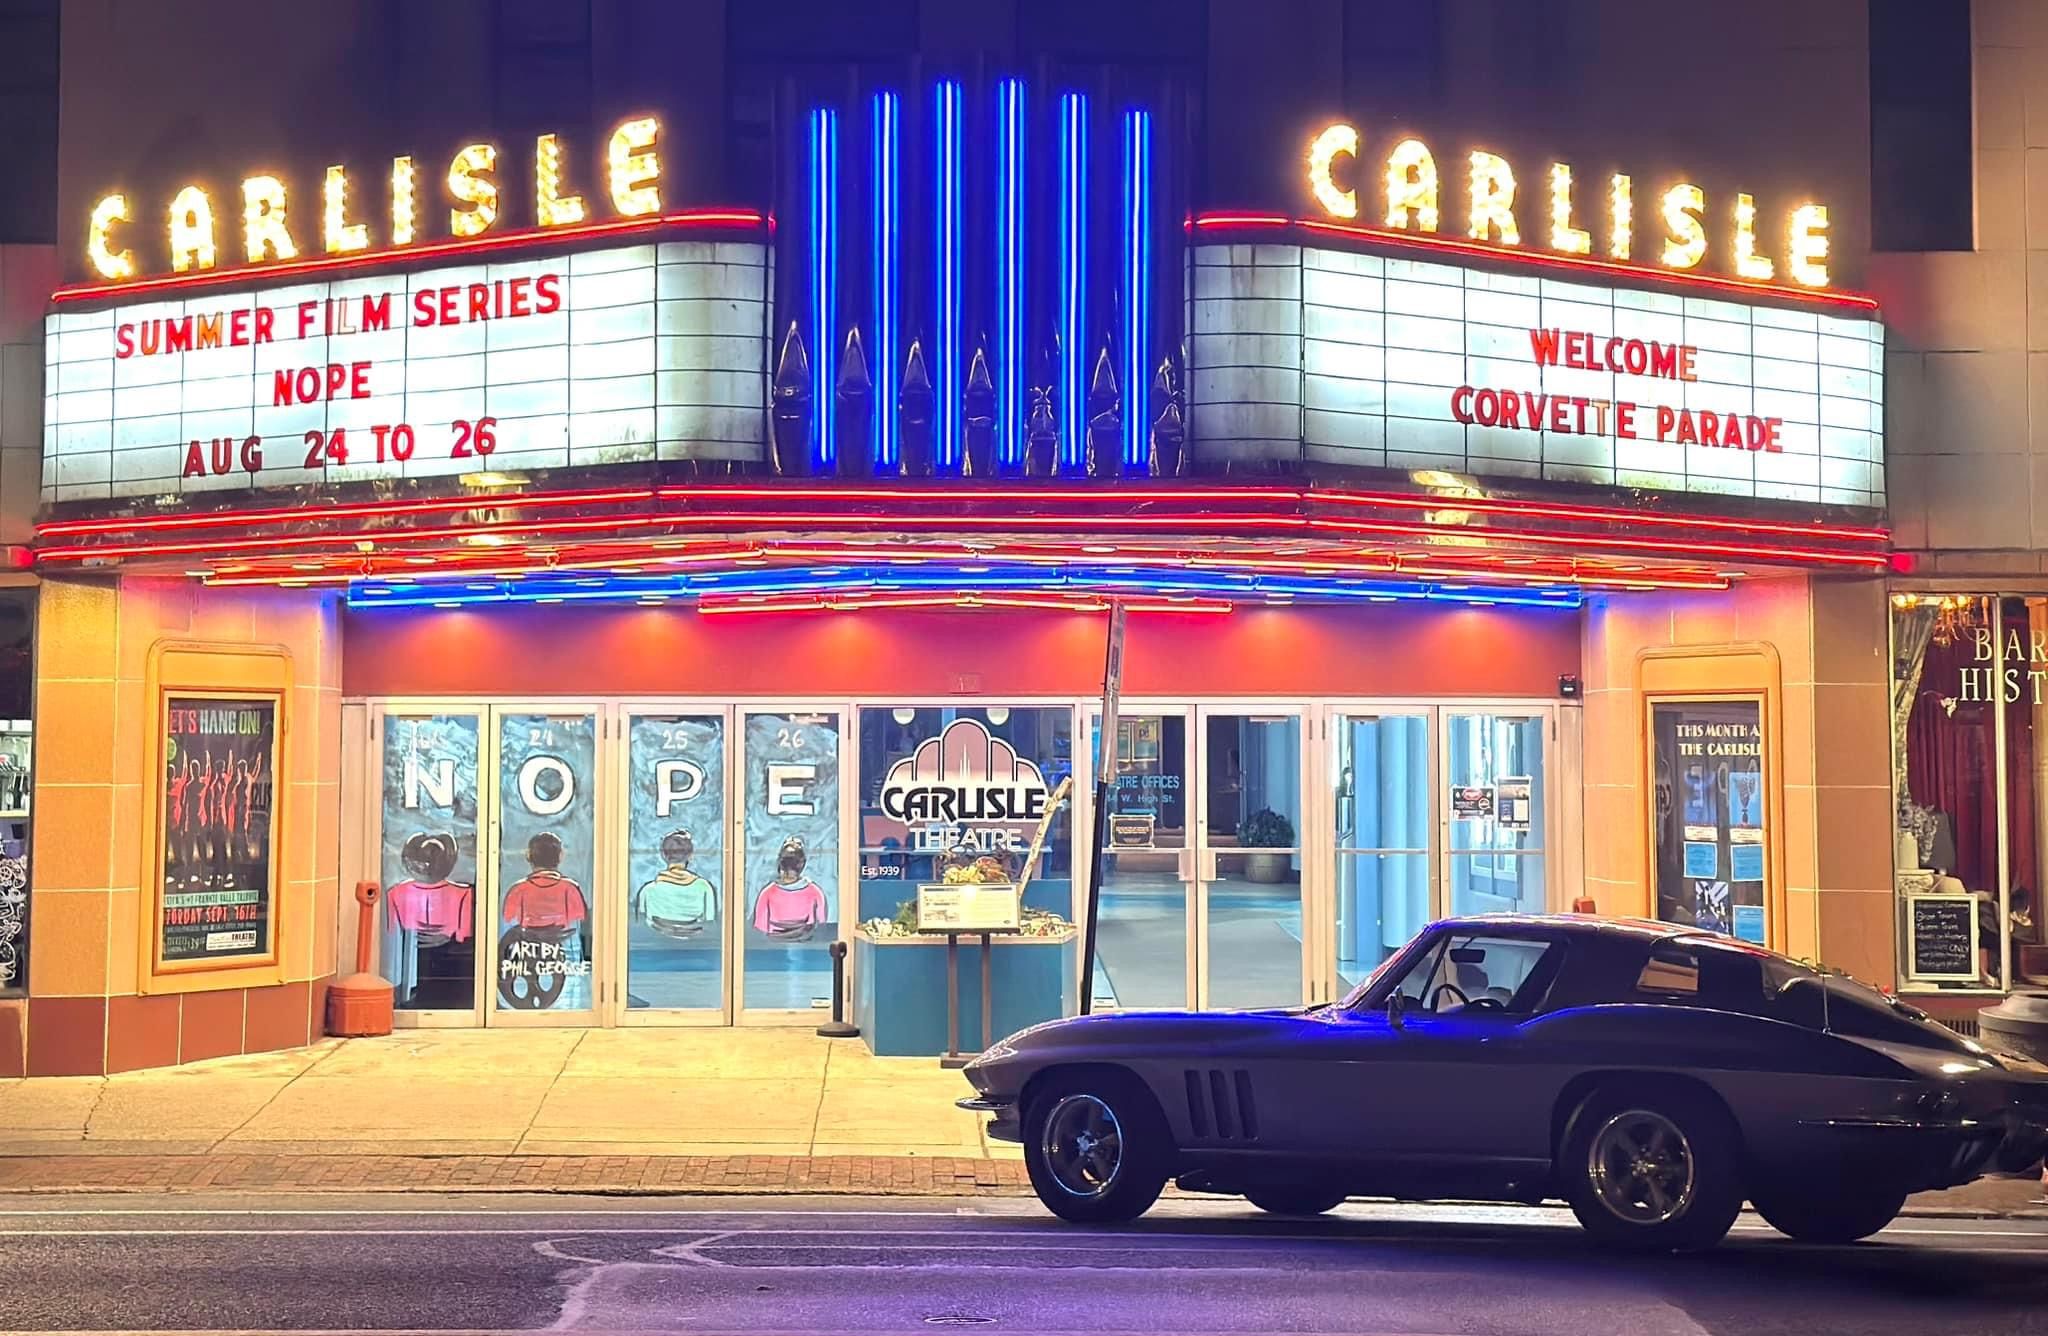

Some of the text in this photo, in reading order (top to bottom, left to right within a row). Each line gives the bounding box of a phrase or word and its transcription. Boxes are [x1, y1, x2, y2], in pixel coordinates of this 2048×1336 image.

[89, 117, 660, 279] CARLISLE
[1307, 124, 1830, 286] CARLISLE
[116, 273, 562, 359] SUMMER FILM SERIES
[1530, 328, 1698, 382] WELCOME
[274, 361, 373, 407] NOPE
[1451, 386, 1784, 454] CORVETTE PARADE
[183, 417, 498, 478] AUG 24 TO 26
[168, 709, 260, 735] ET'S HANG ON!
[1676, 724, 1704, 737] THIS
[1704, 724, 1748, 737] MONTH
[528, 728, 554, 747] 24
[662, 729, 689, 749] 25
[777, 727, 806, 748] 26
[1679, 743, 1704, 756] THE
[1141, 775, 1180, 789] OFFICES
[883, 786, 1046, 824] CARLISLE
[909, 827, 1023, 851] THEATRE
[879, 865, 900, 876] 1939
[166, 907, 202, 925] TURDAY
[509, 940, 540, 960] ART
[501, 959, 592, 980] PHIL GEORGE
